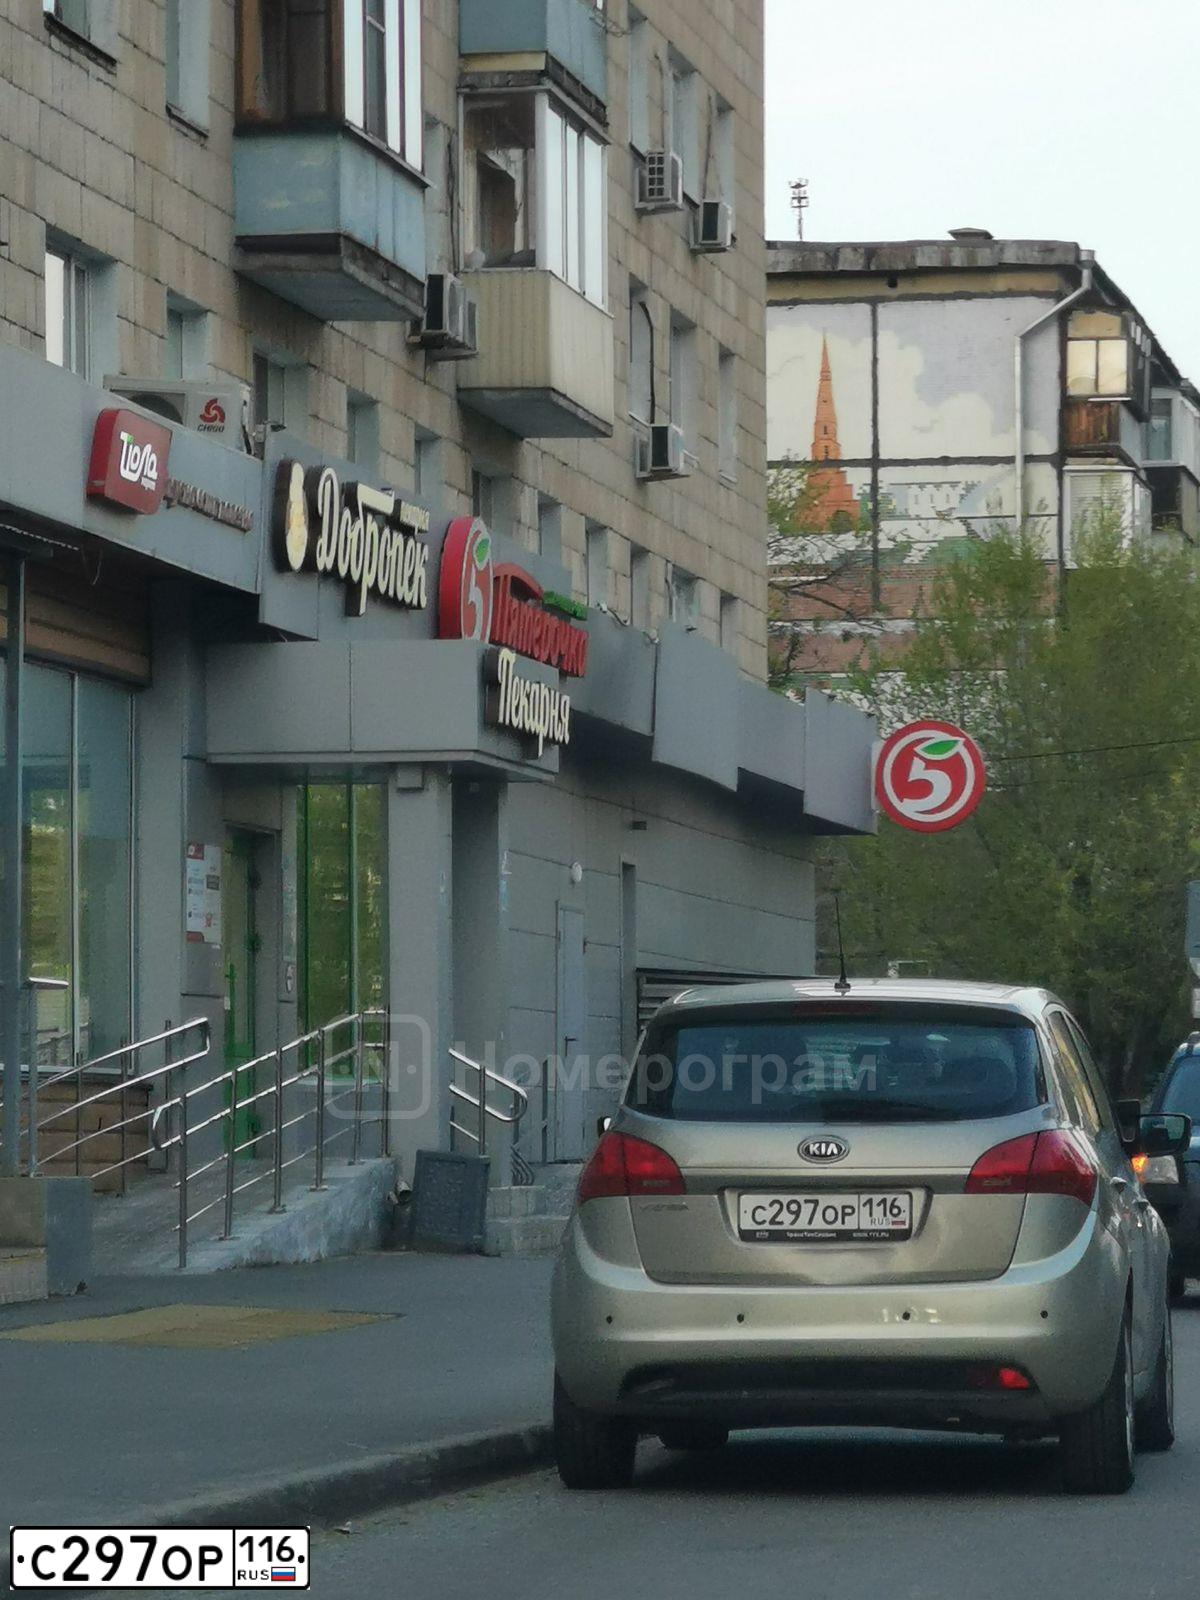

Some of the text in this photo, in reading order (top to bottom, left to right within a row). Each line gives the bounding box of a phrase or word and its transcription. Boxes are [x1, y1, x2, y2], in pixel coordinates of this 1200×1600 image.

[316, 467, 429, 616] Добропек
[498, 647, 570, 757] Пекарня
[809, 1142, 838, 1156] KIA
[751, 1197, 902, 1226] С297ОР 116
[870, 1217, 891, 1226] RUS
